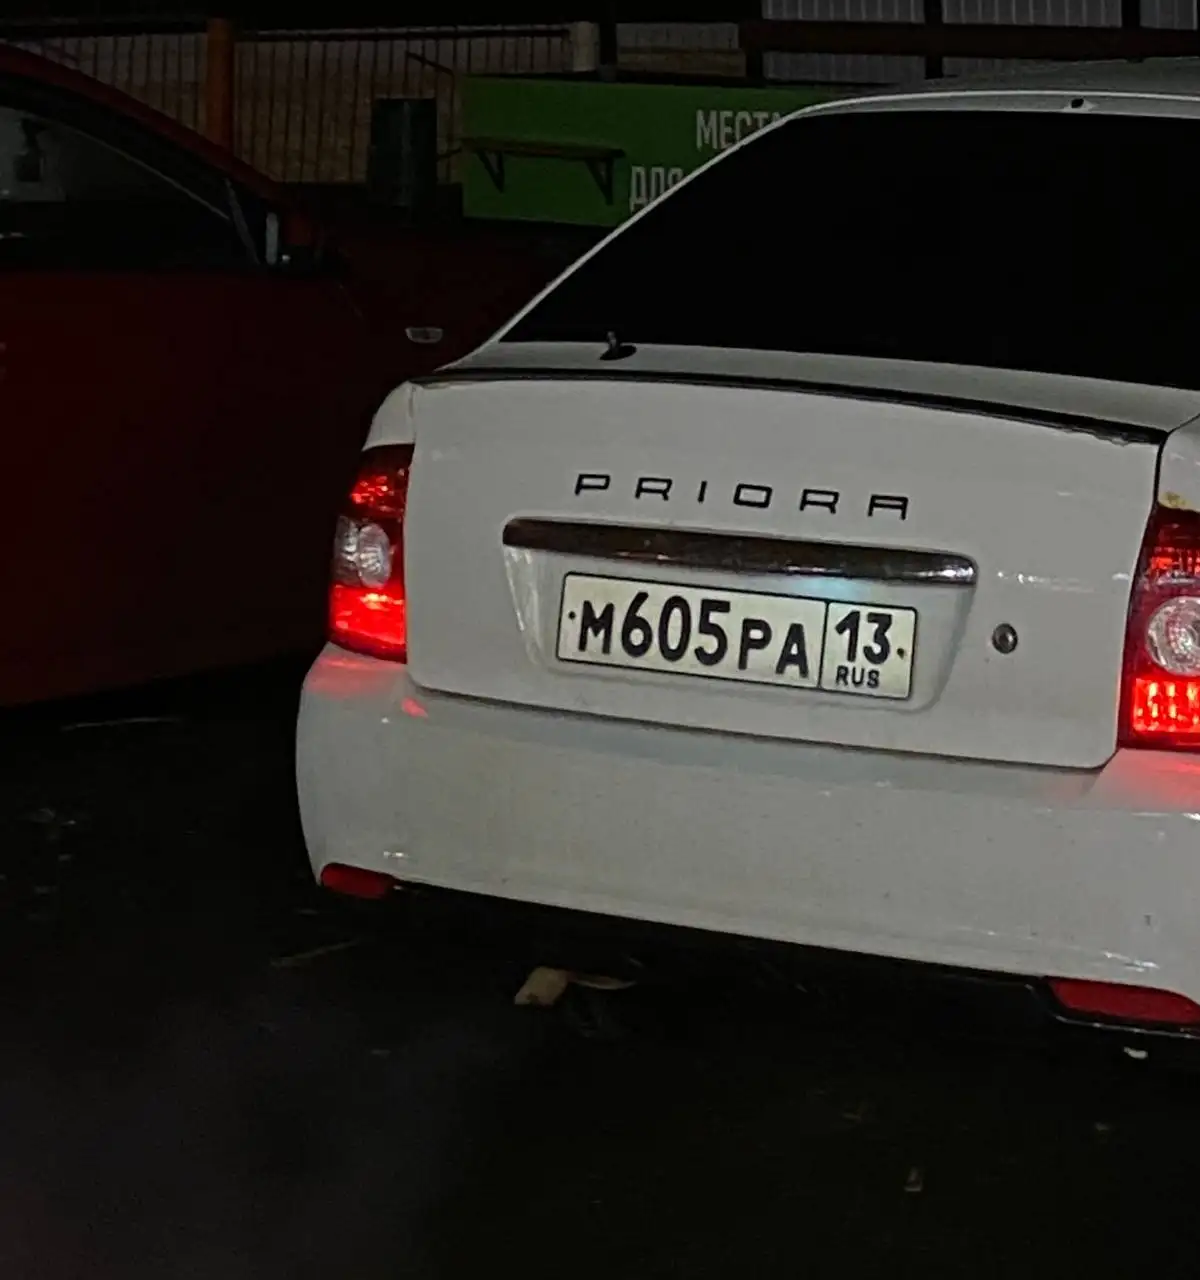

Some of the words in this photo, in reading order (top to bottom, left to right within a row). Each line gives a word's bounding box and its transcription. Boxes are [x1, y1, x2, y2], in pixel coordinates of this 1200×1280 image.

[696, 109, 781, 150] МЕСТ
[575, 474, 908, 520] PRIORA
[579, 592, 809, 678] М605РА
[835, 611, 893, 664] 13
[835, 665, 880, 688] RUS
